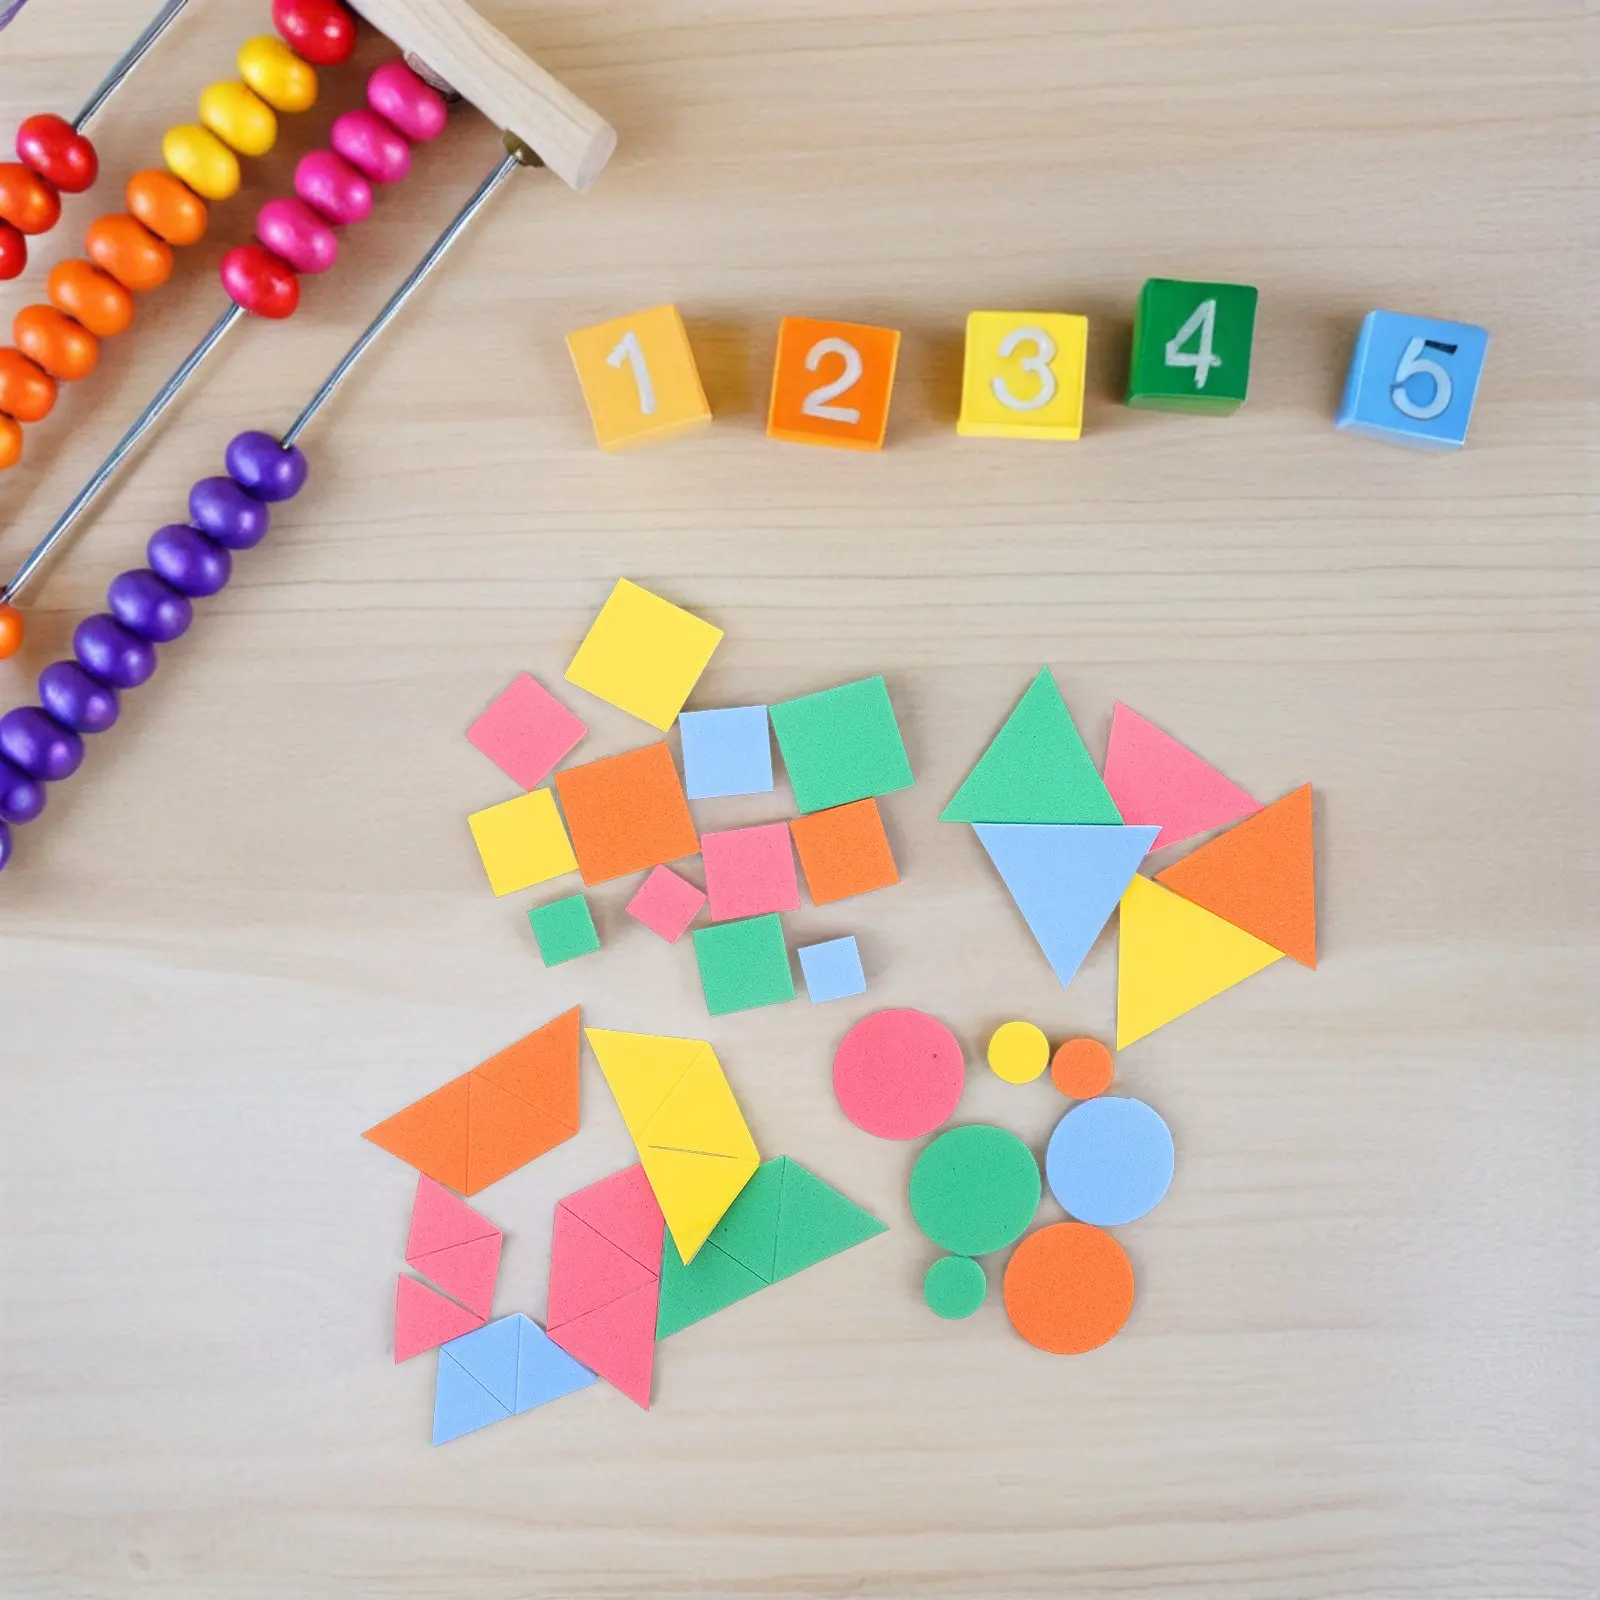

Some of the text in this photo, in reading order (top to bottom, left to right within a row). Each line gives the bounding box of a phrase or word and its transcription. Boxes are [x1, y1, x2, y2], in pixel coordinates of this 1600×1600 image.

[606, 331, 657, 415] 1
[801, 337, 863, 424] 2
[991, 326, 1057, 412] 3
[1165, 299, 1222, 389] 4
[1391, 336, 1458, 420] 5
